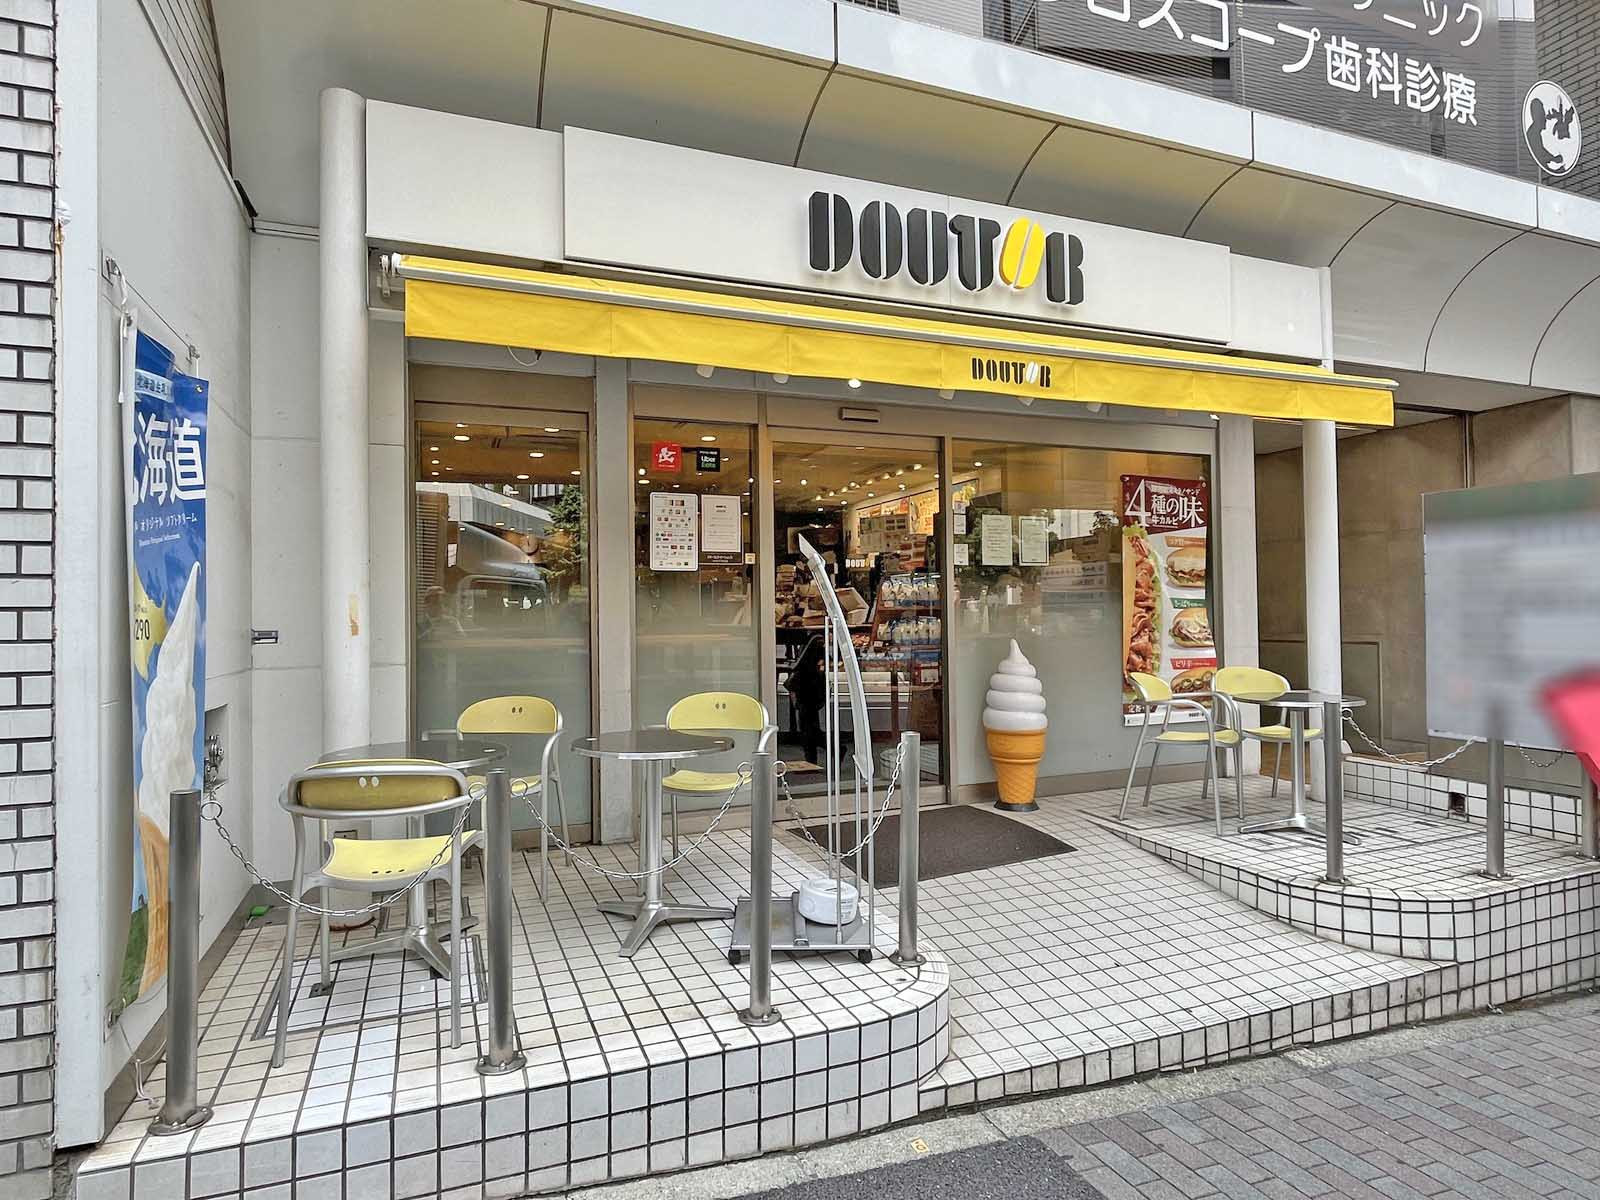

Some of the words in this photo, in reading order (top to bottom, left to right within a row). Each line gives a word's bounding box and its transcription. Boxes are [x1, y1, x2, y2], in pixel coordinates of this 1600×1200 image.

[808, 191, 1085, 306] DOUTOR
[971, 357, 1051, 388] DOUTOR
[133, 412, 206, 505] 海道
